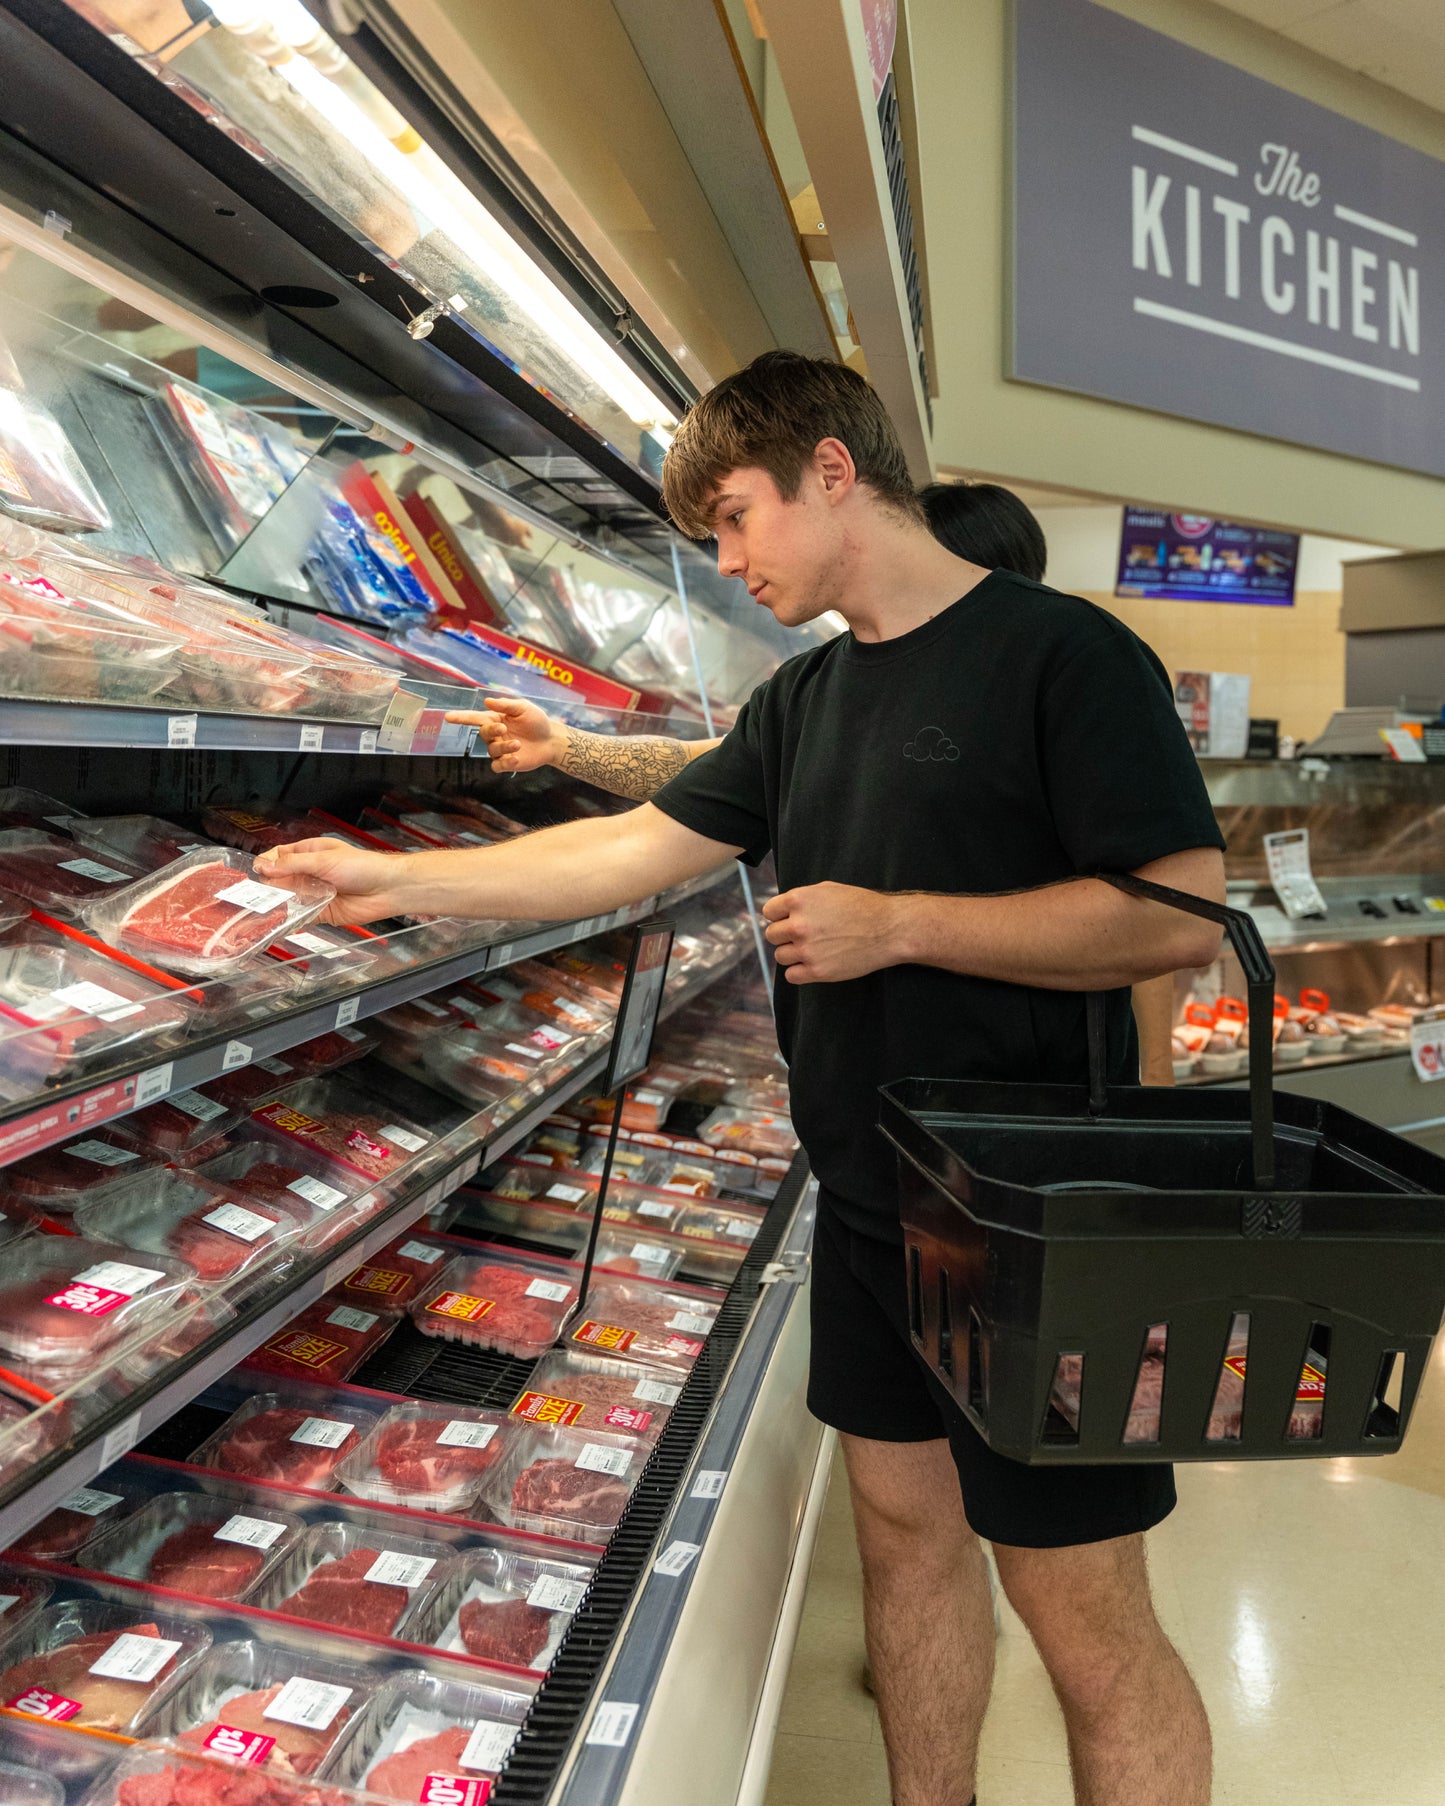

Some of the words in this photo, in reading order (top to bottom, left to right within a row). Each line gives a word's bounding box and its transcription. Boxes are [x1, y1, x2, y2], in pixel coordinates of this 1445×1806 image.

[1254, 143, 1321, 207] The
[1132, 165, 1420, 356] KITCHEN
[428, 531, 464, 582] Unico
[515, 646, 574, 685] Unico
[386, 714, 405, 728] LIMIT
[275, 1113, 313, 1132] SIZE
[368, 1271, 398, 1292] SIZE
[52, 1284, 101, 1311] 30%
[449, 1298, 481, 1317] SIZE
[279, 1333, 312, 1352] Family
[293, 1338, 331, 1360] SIZE
[596, 1327, 625, 1348] SIZE
[520, 1394, 546, 1419] Family
[536, 1399, 569, 1424] SIZE
[610, 1405, 634, 1428] 30%
[10, 1690, 53, 1716] 0%
[427, 1778, 464, 1806] 0%
